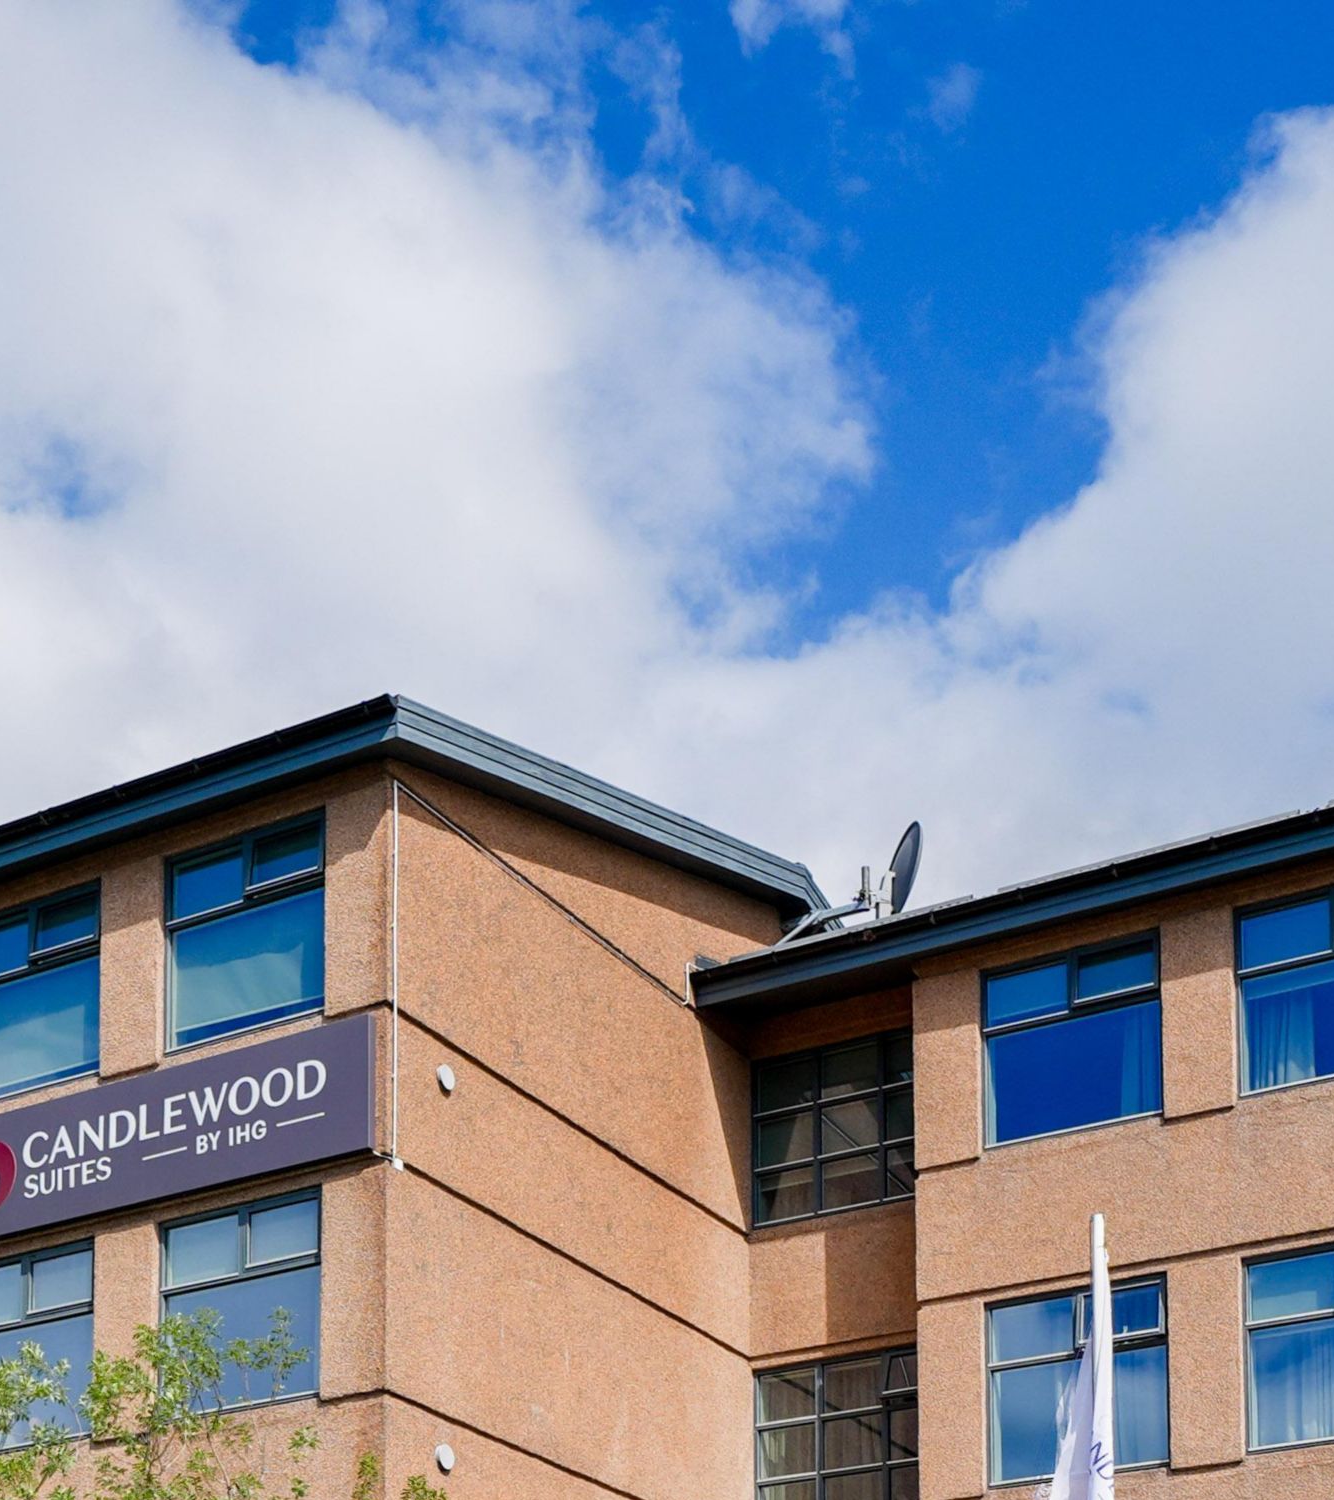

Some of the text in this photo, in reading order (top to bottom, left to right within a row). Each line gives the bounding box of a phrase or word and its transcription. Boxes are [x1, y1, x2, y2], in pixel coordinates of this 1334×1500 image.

[22, 1058, 327, 1169] CANDLEWOOD
[195, 1120, 268, 1155] BY IHG
[23, 1156, 112, 1199] SUITES
